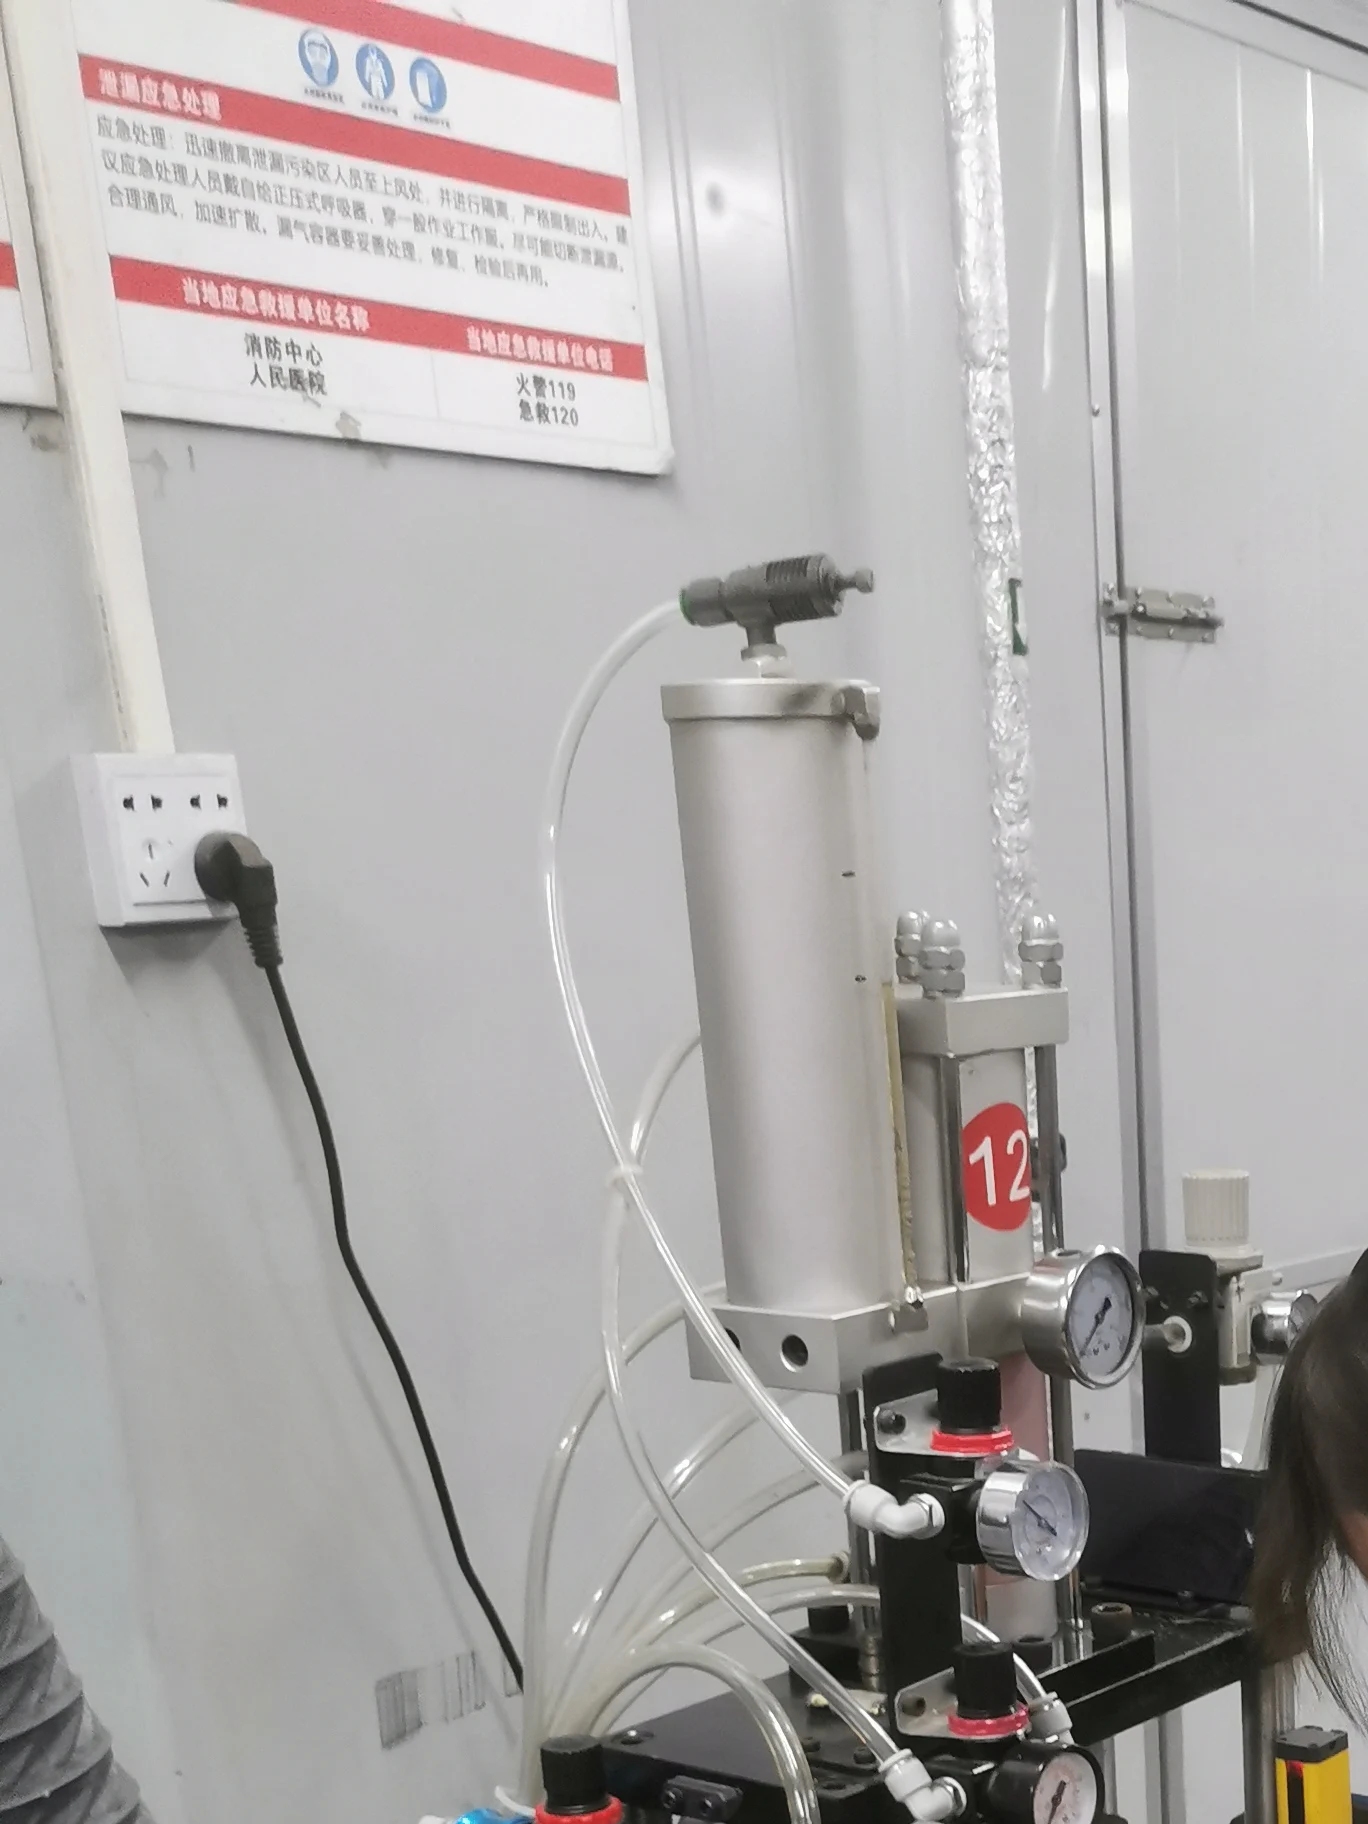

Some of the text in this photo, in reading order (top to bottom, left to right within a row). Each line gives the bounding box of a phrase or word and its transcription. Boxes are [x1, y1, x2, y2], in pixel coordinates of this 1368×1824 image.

[98, 68, 222, 121] 泄漏应急处理
[182, 277, 370, 332] 当地应急救援单位名称
[244, 332, 323, 367] 消防中心
[466, 325, 614, 373] 当地应急救援单位电话
[250, 362, 328, 396] 人民医院
[516, 372, 576, 401] 火警119
[519, 399, 579, 427] 急救120
[969, 1129, 1031, 1207] 12
